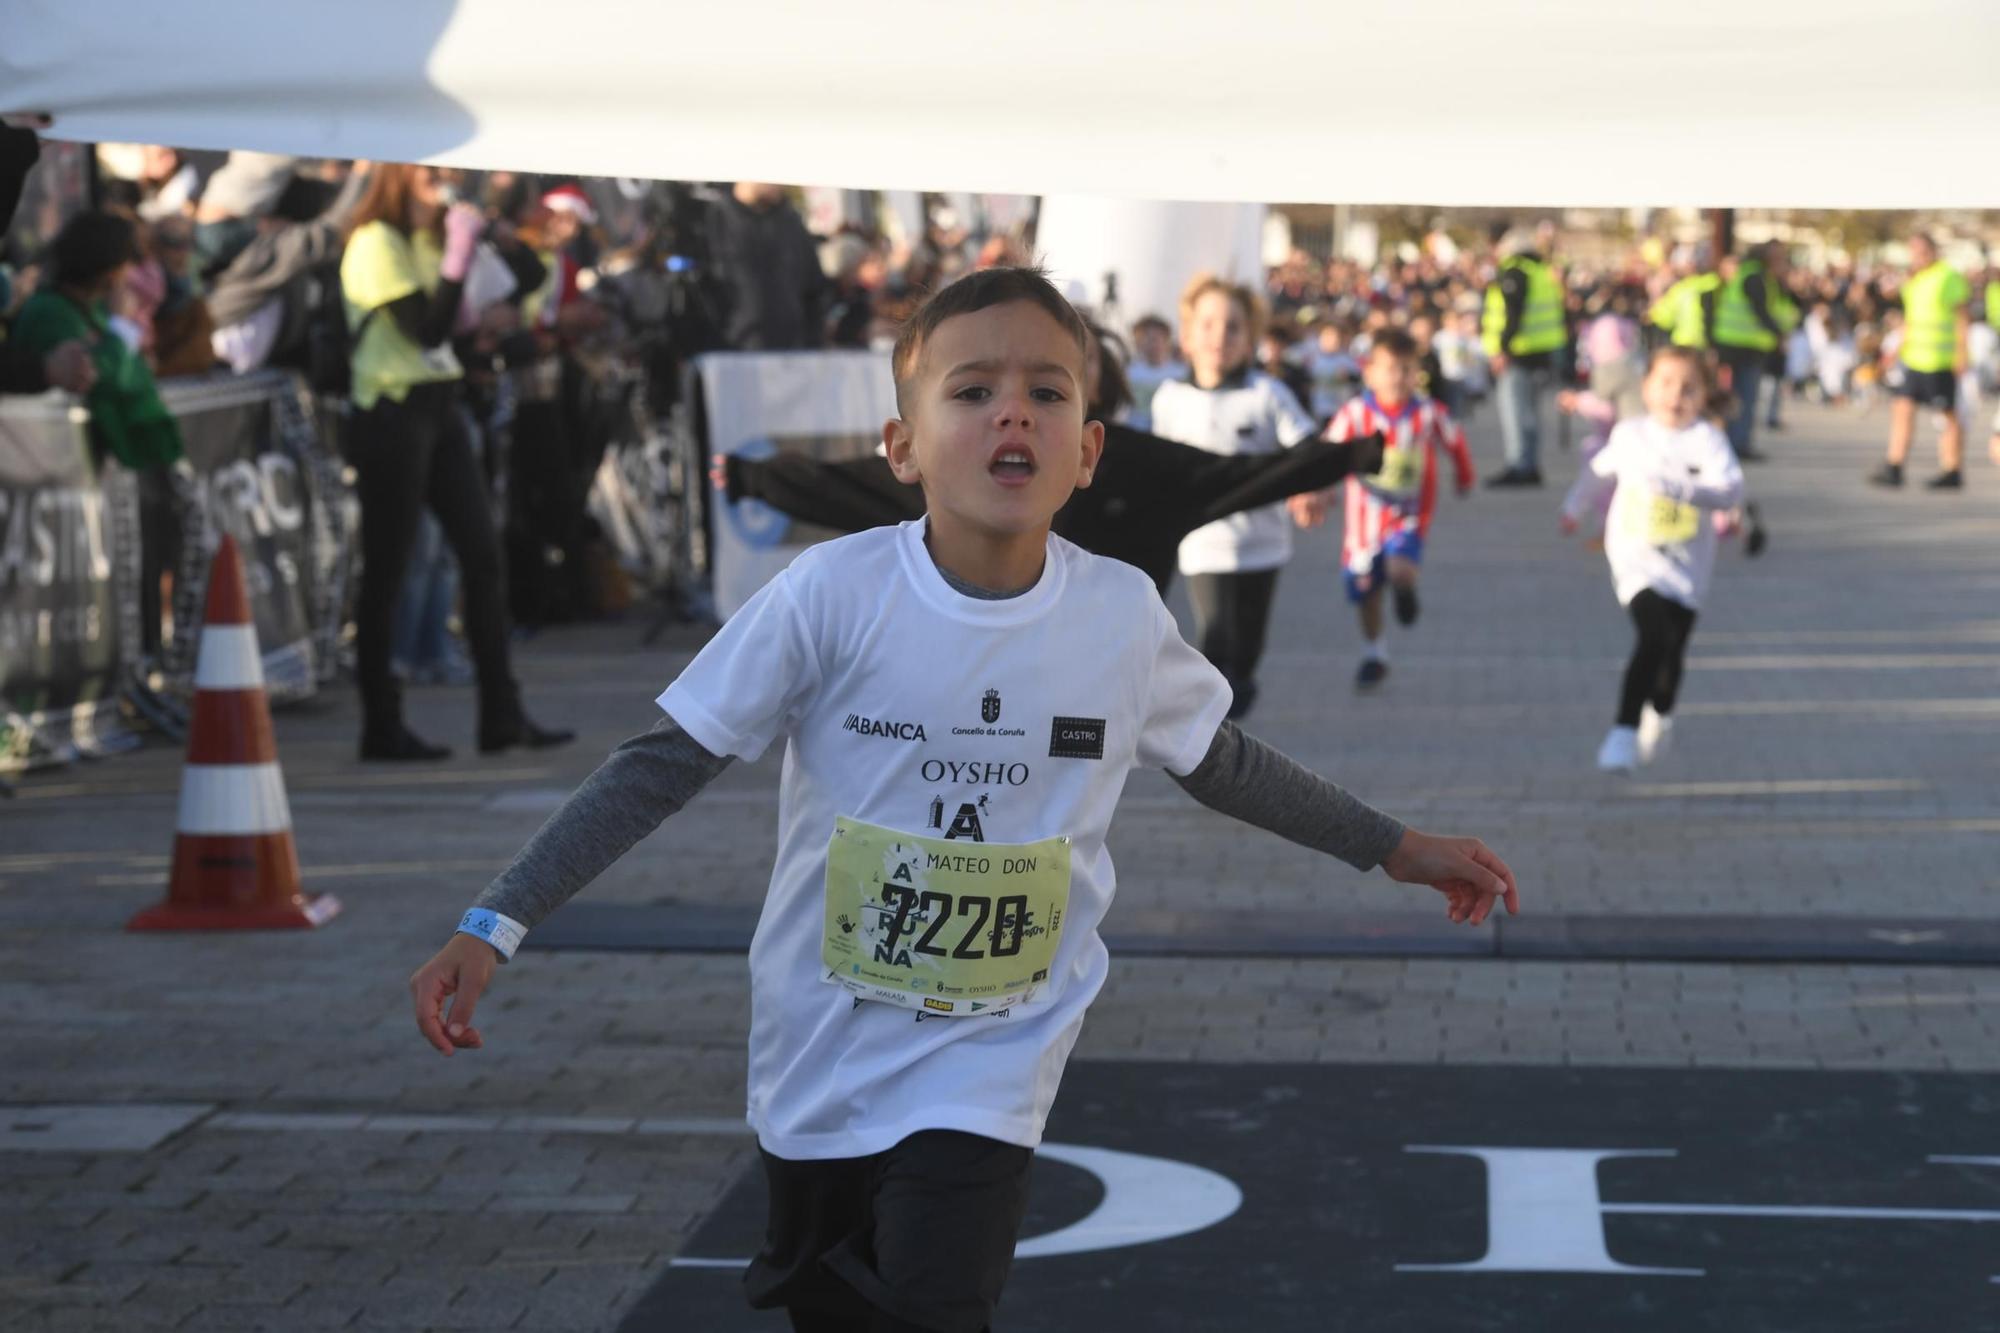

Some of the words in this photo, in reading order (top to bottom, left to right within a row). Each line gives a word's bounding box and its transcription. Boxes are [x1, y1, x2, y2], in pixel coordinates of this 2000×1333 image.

[846, 713, 928, 742] ABANCA
[952, 727, 985, 736] Concello
[986, 727, 997, 737] da
[998, 727, 1026, 737] Coruña
[1061, 729, 1097, 742] CASTRO
[921, 759, 1030, 786] OYSHO
[927, 853, 991, 874] MATEO
[1002, 856, 1037, 874] DON
[881, 882, 1028, 960] 7220
